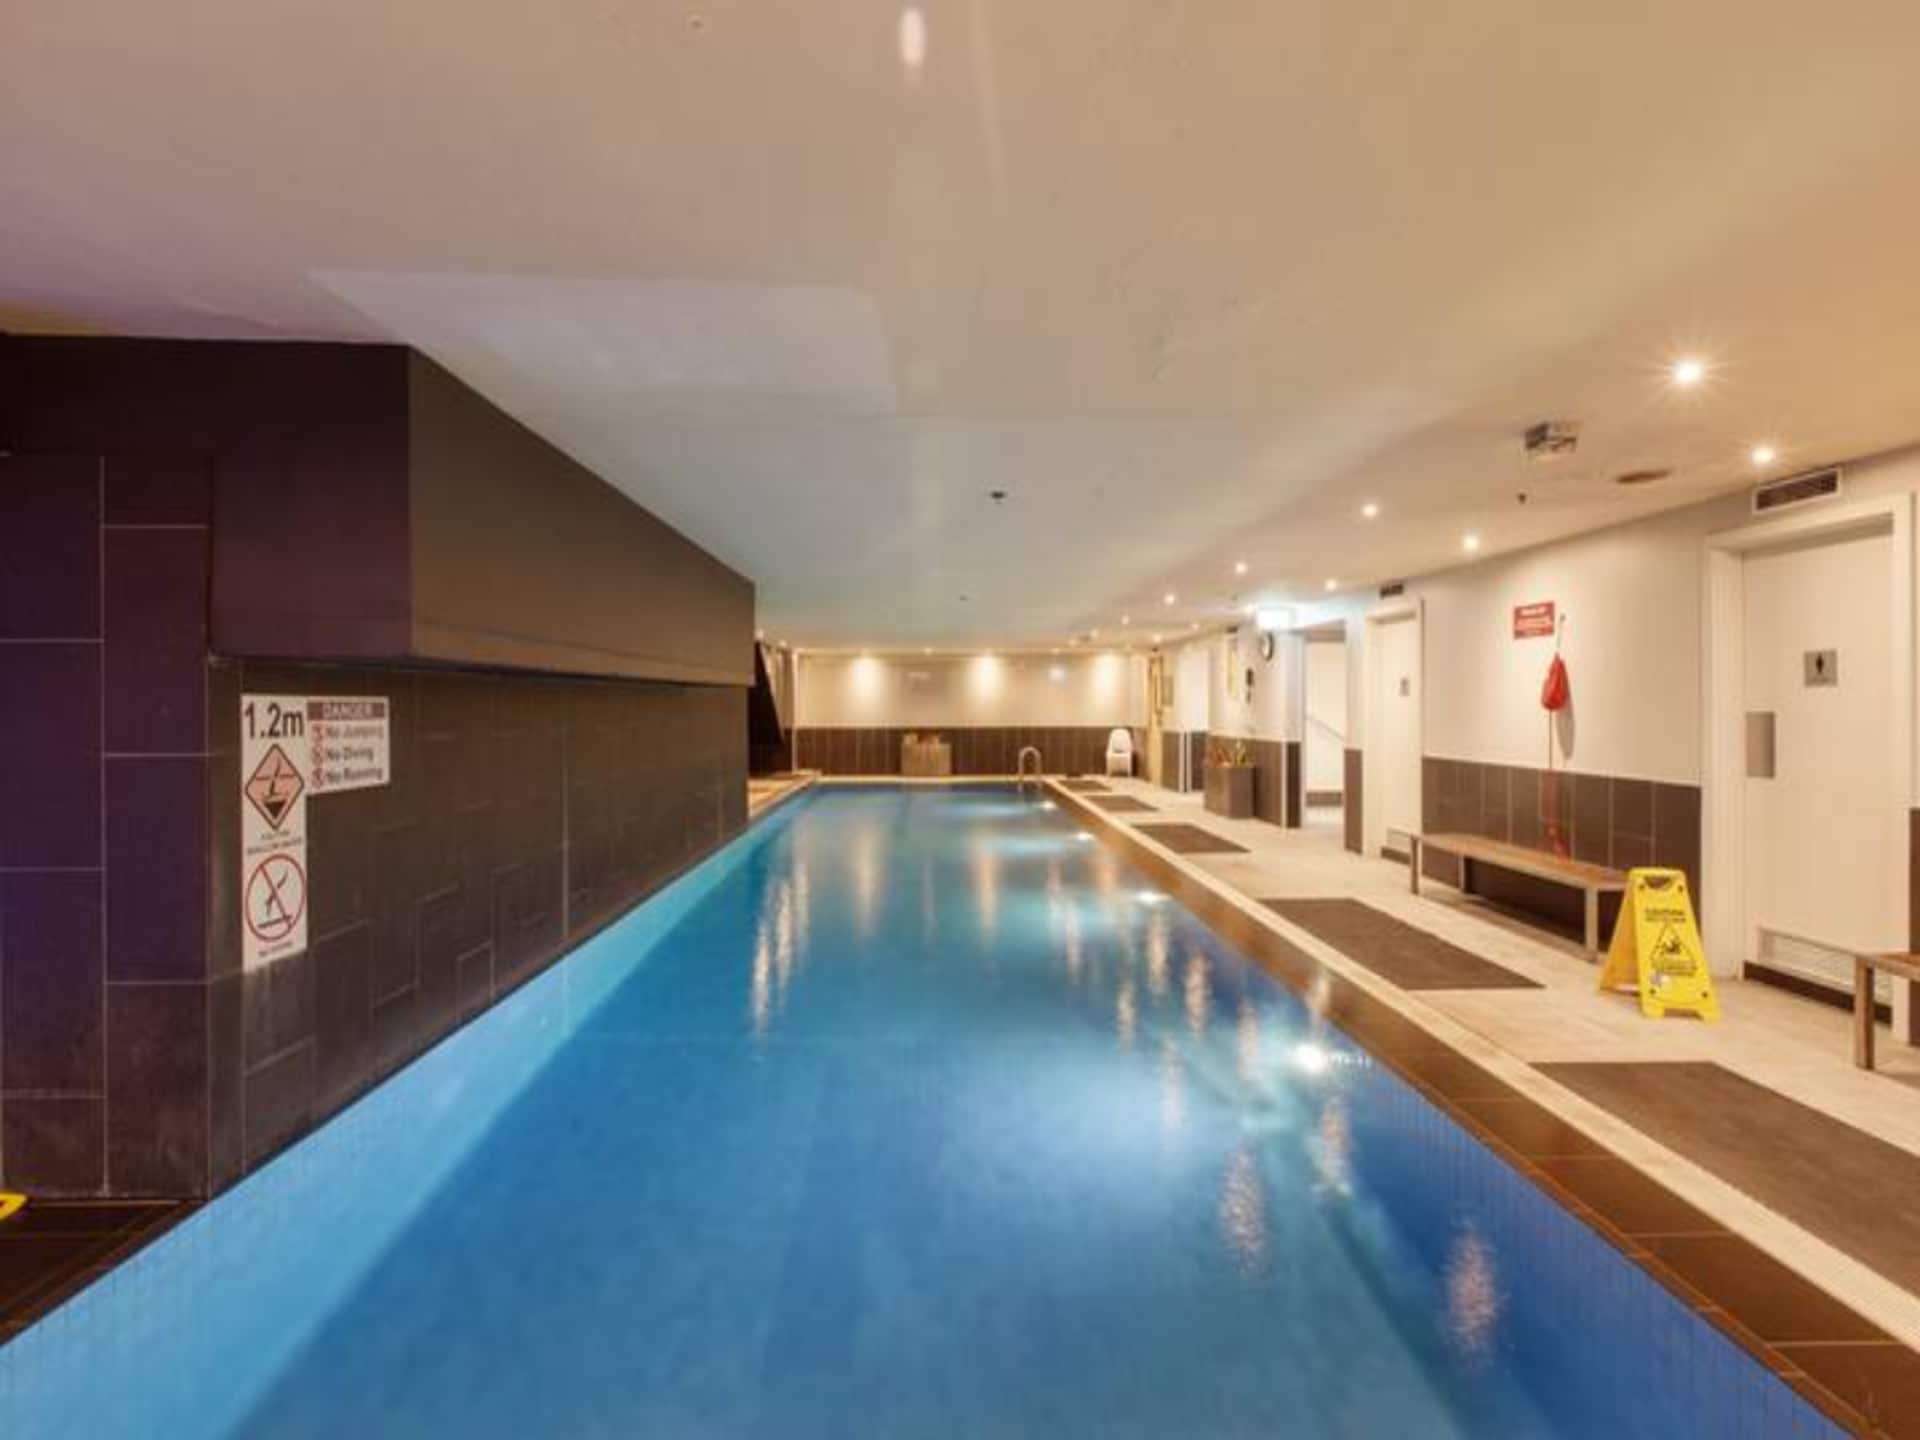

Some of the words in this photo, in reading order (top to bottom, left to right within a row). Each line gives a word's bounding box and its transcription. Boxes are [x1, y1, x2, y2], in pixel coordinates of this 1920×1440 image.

[323, 703, 372, 718] DANGER
[244, 702, 304, 739] 1.2m
[326, 726, 341, 738] No
[326, 747, 341, 760] No
[326, 771, 341, 784] No
